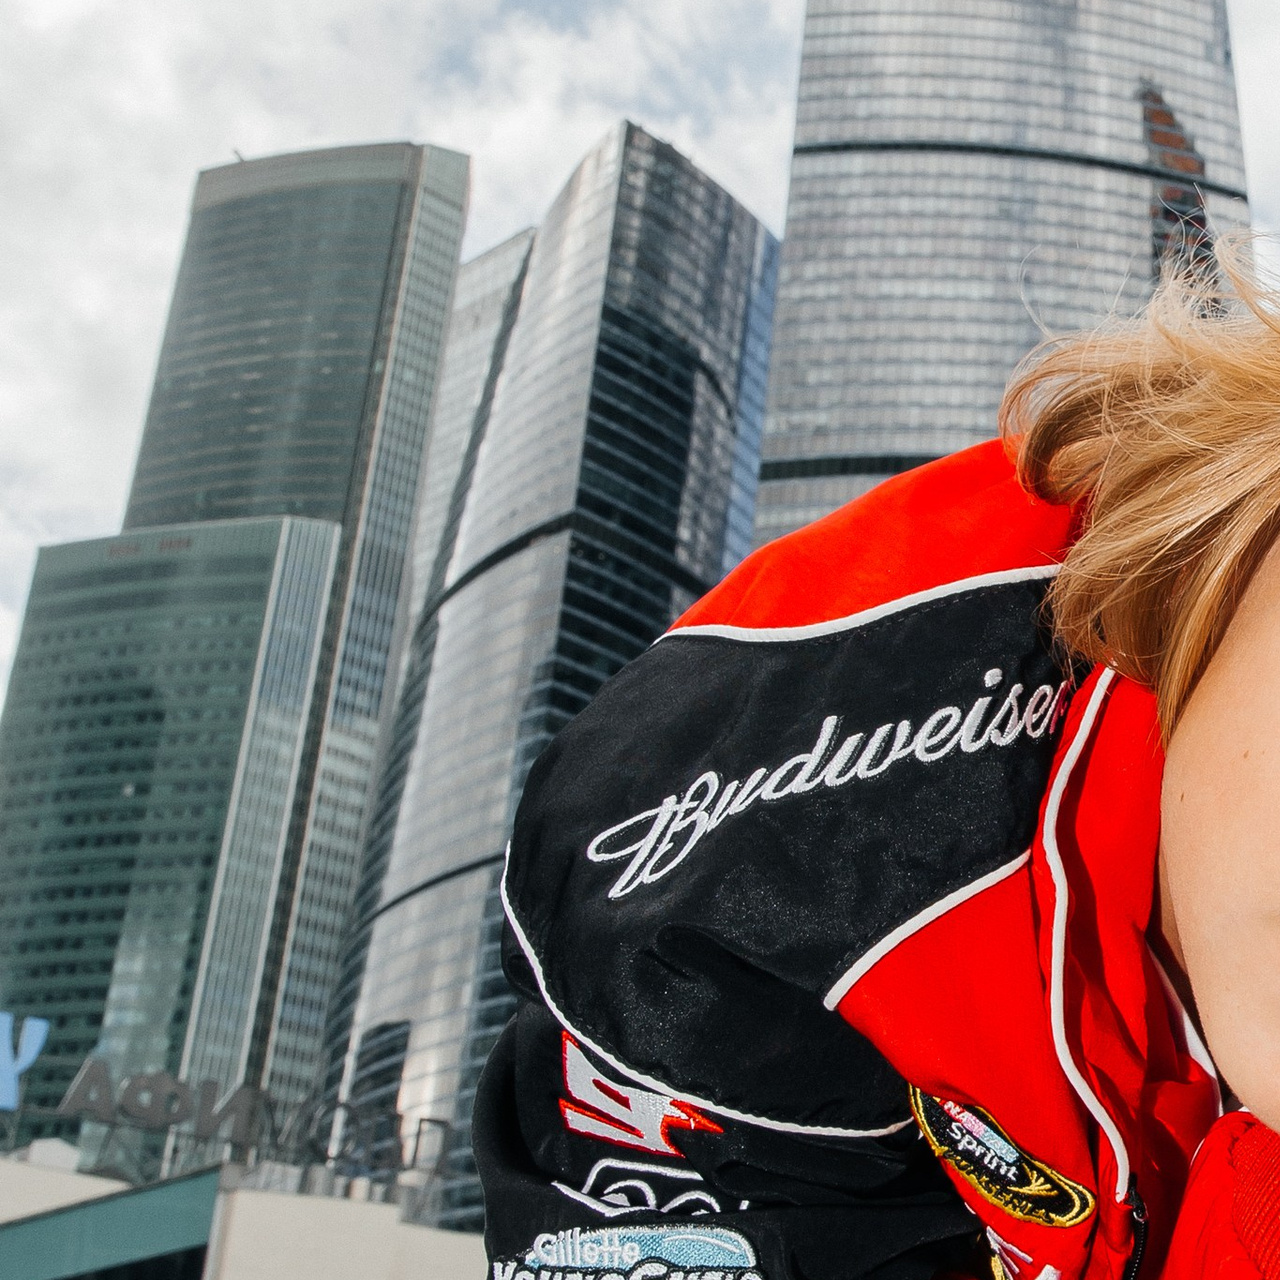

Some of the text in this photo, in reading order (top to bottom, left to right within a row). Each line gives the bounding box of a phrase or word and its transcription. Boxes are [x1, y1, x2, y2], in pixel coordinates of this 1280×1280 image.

[587, 667, 1073, 898] Budweiser
[947, 1122, 1019, 1182] Sprint
[533, 1227, 641, 1266] Gillette
